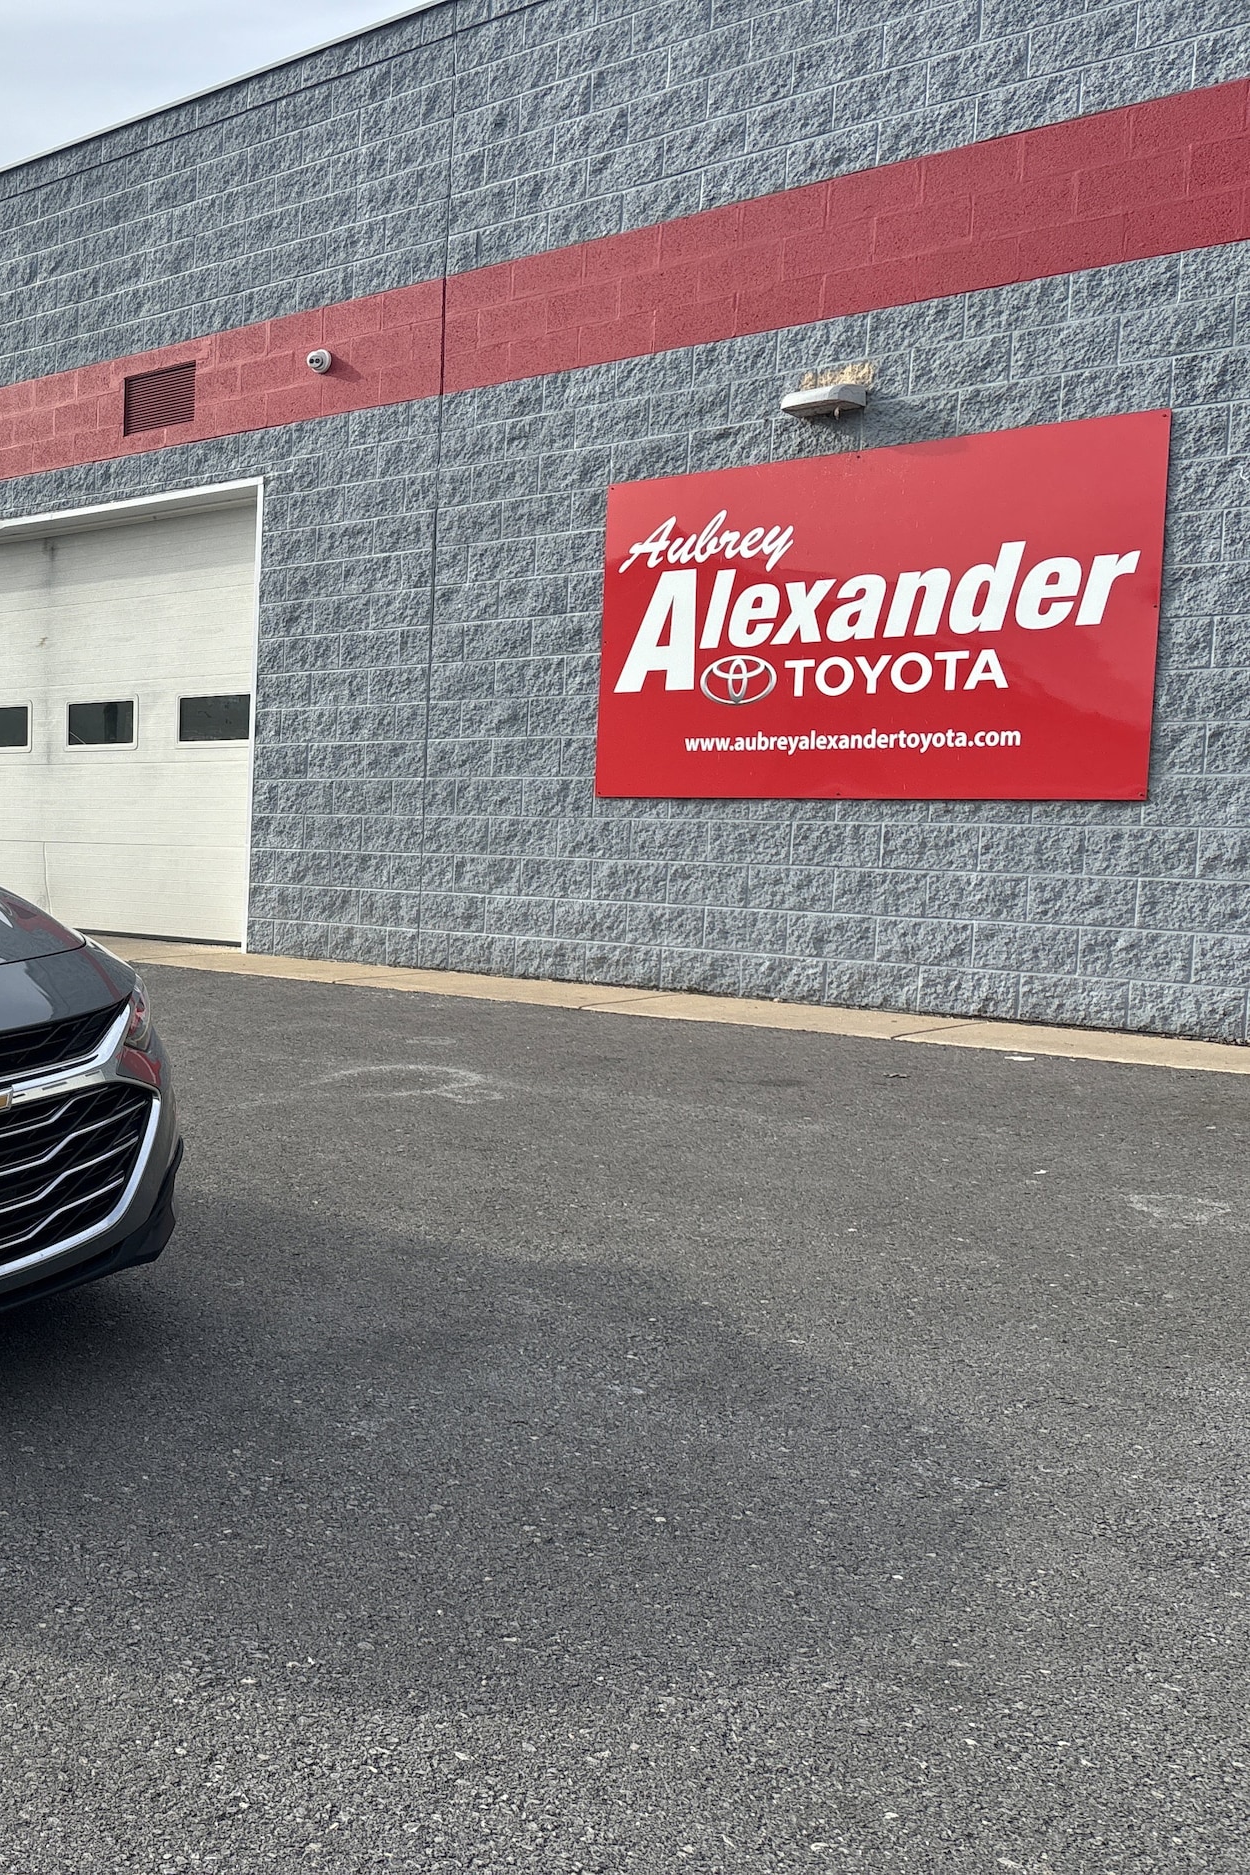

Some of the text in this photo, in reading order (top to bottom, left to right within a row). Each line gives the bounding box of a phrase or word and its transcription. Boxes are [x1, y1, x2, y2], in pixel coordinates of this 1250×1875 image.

[619, 509, 794, 573] Aubrey
[614, 540, 1141, 693] Alexander
[786, 649, 1008, 697] TOYOTA
[684, 729, 1021, 755] www.aubreyalexandertoyota.com
